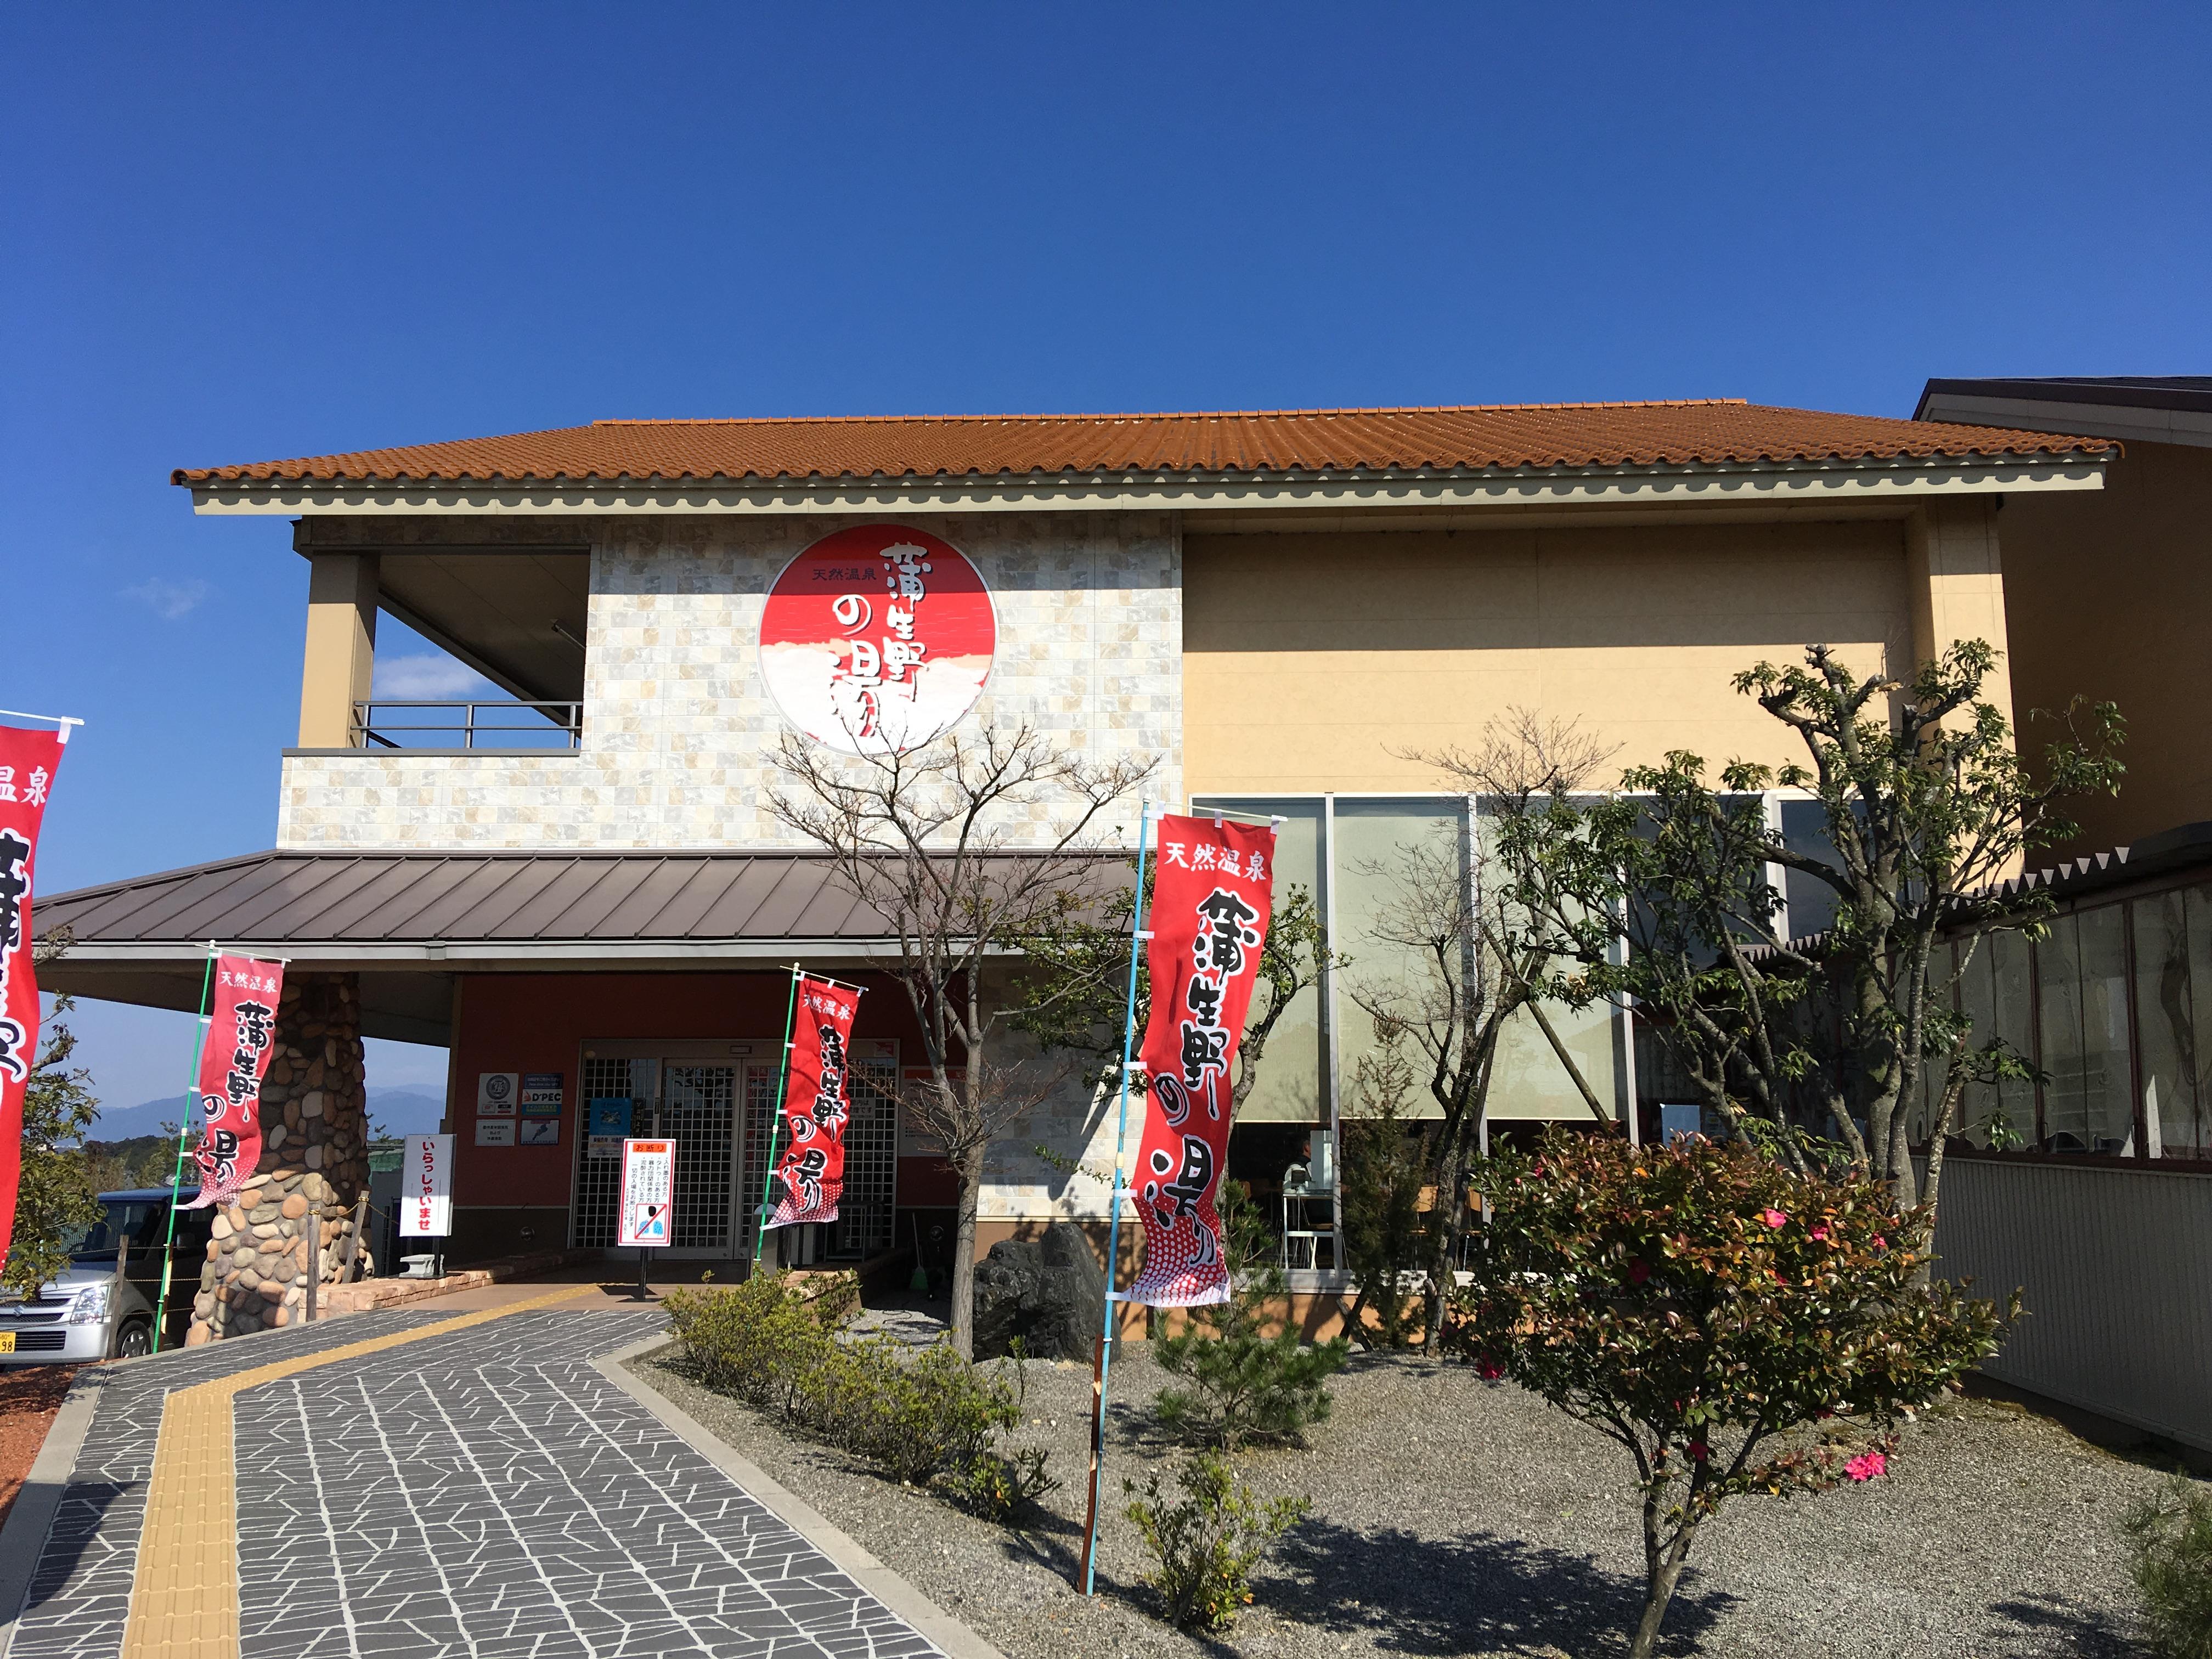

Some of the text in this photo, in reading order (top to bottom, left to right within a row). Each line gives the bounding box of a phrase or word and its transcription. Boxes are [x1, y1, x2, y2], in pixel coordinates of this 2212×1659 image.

[812, 568, 877, 581] 天然温泉
[879, 541, 932, 703] 蒲生野
[1164, 842, 1266, 882] 天然温泉
[219, 970, 277, 994] 天然温泉
[802, 994, 851, 1020] 天然温泉
[419, 1141, 435, 1231] いらっしゃいませ
